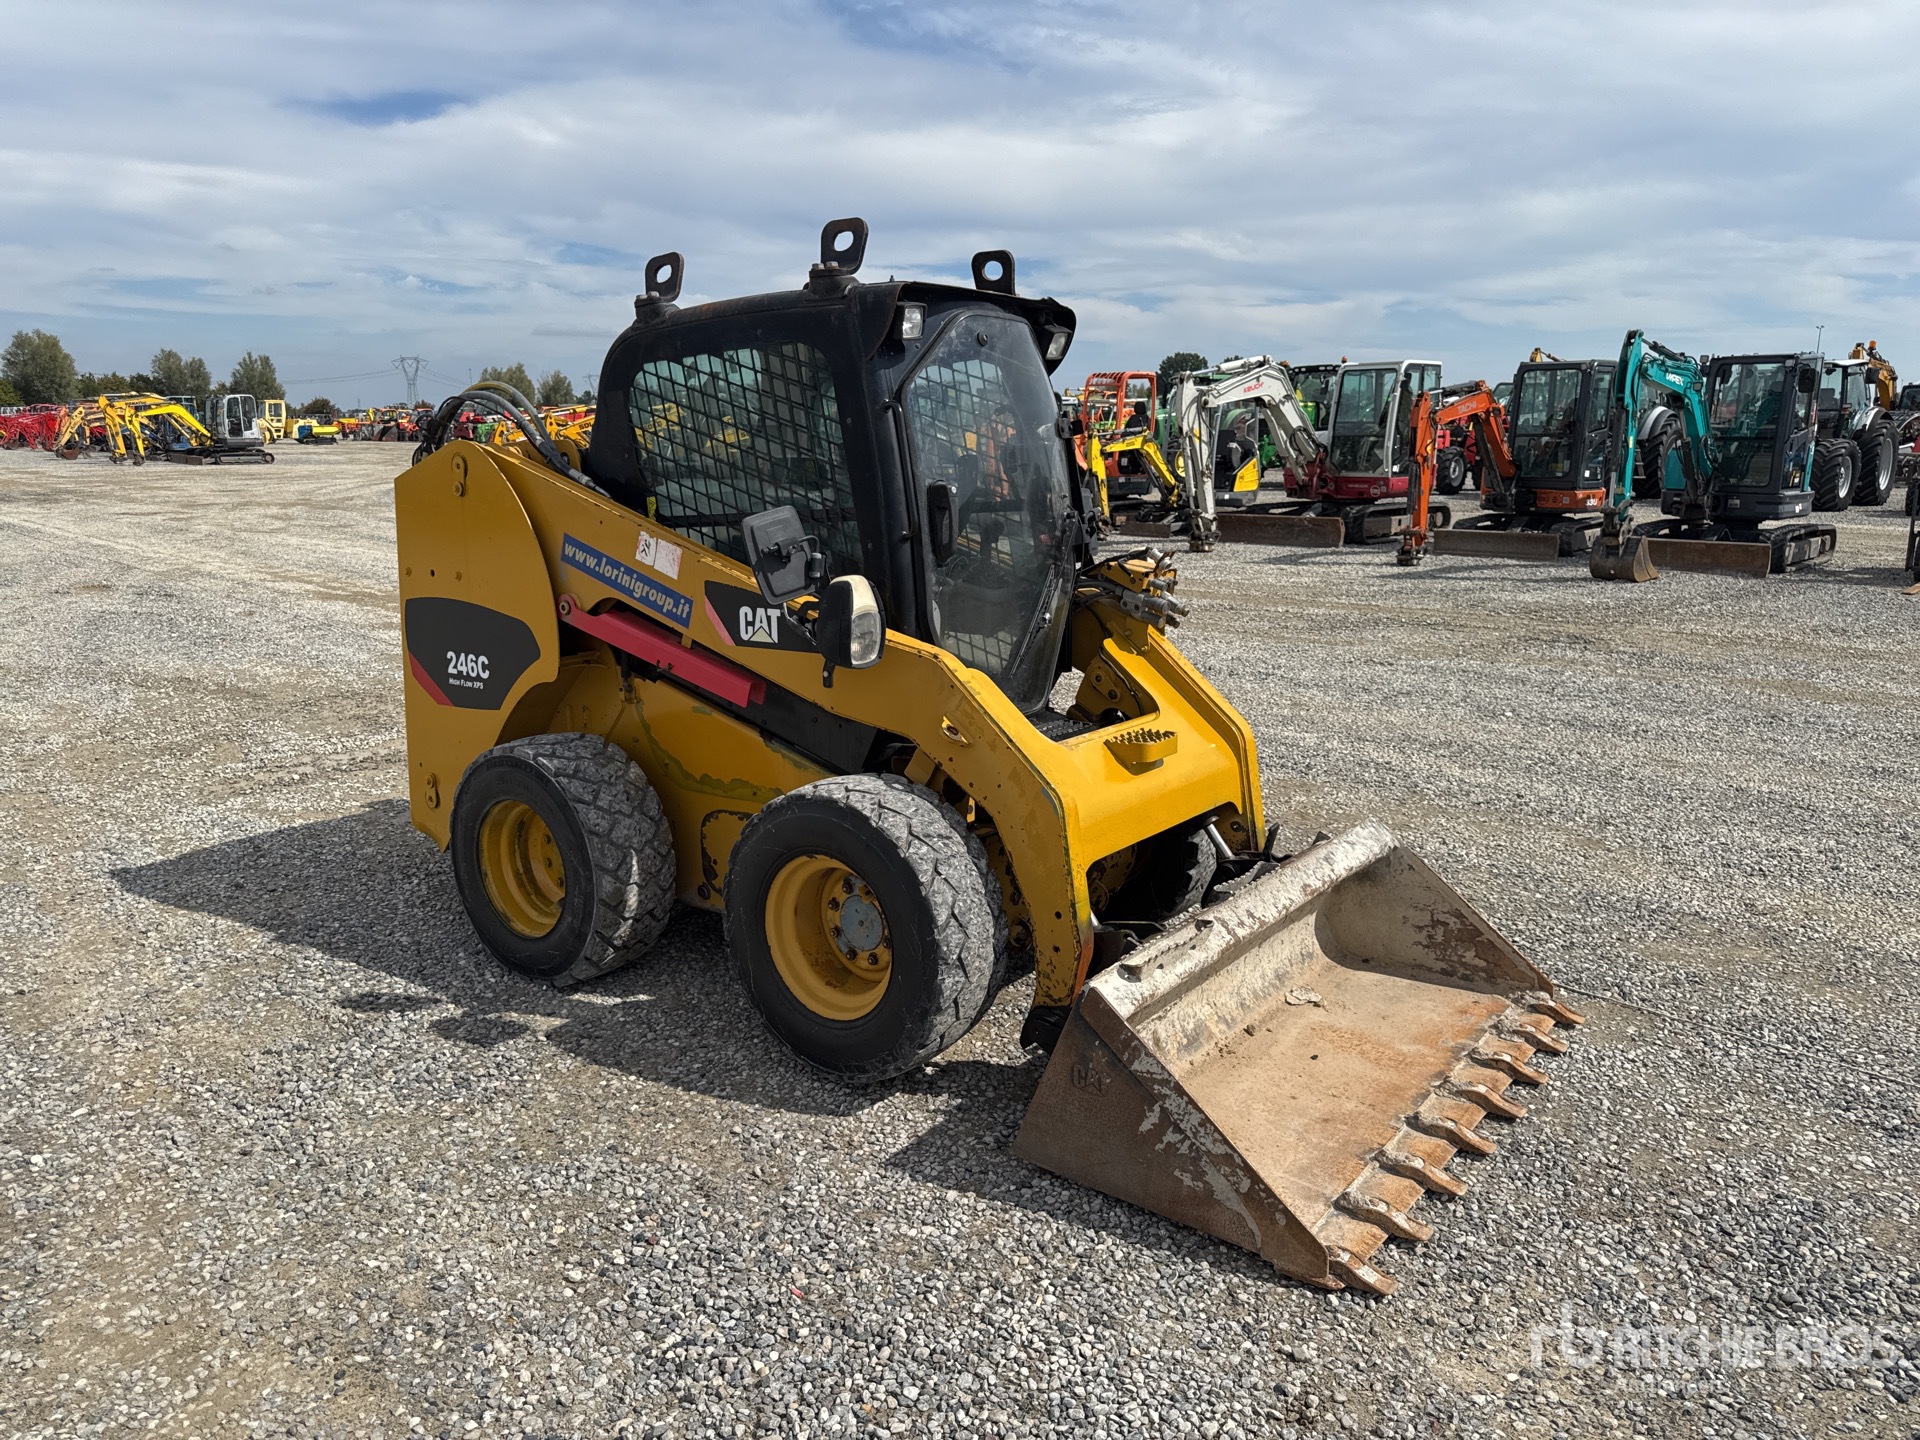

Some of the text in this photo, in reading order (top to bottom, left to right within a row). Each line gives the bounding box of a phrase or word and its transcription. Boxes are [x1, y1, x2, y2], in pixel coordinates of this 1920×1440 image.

[564, 543, 690, 619] www.lorinigroup.it
[739, 606, 781, 643] CAT
[446, 651, 490, 679] 246C
[473, 681, 484, 690] XPS
